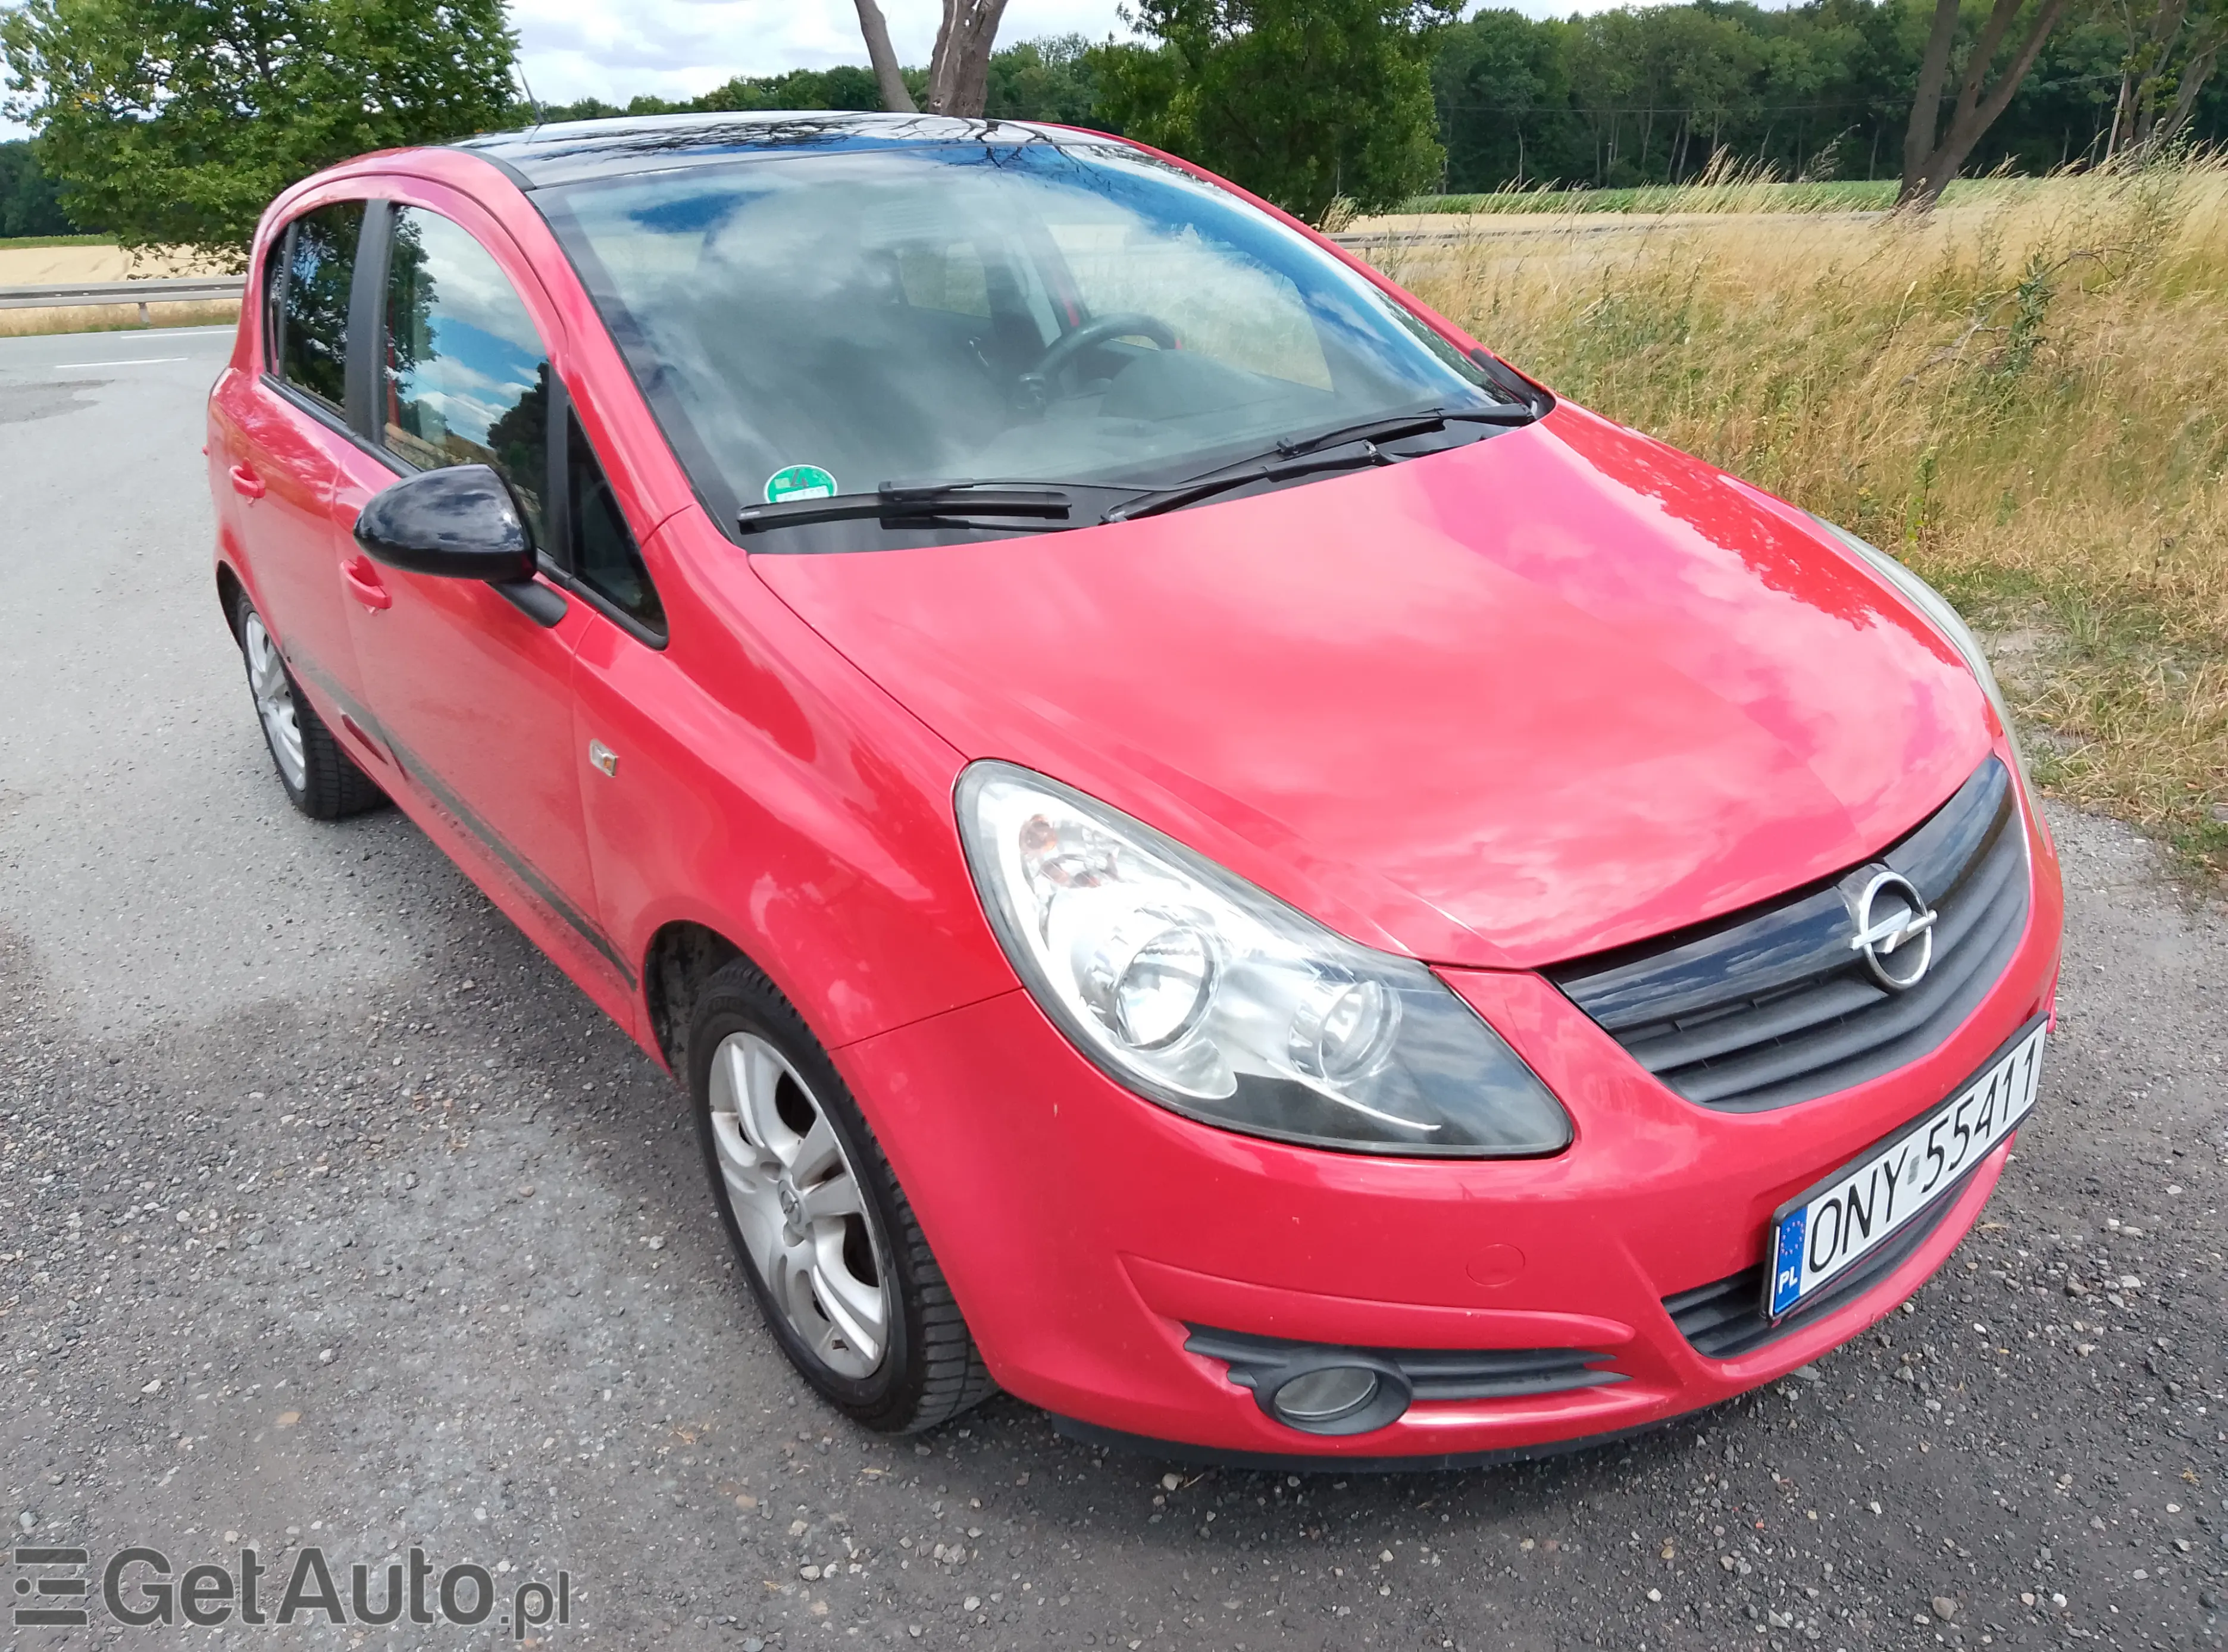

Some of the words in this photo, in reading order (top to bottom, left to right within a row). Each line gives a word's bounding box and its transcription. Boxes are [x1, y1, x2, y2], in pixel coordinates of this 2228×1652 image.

[1809, 1144, 1909, 1274] ONY
[1921, 1036, 2036, 1194] 55411
[1779, 1266, 1798, 1295] PL
